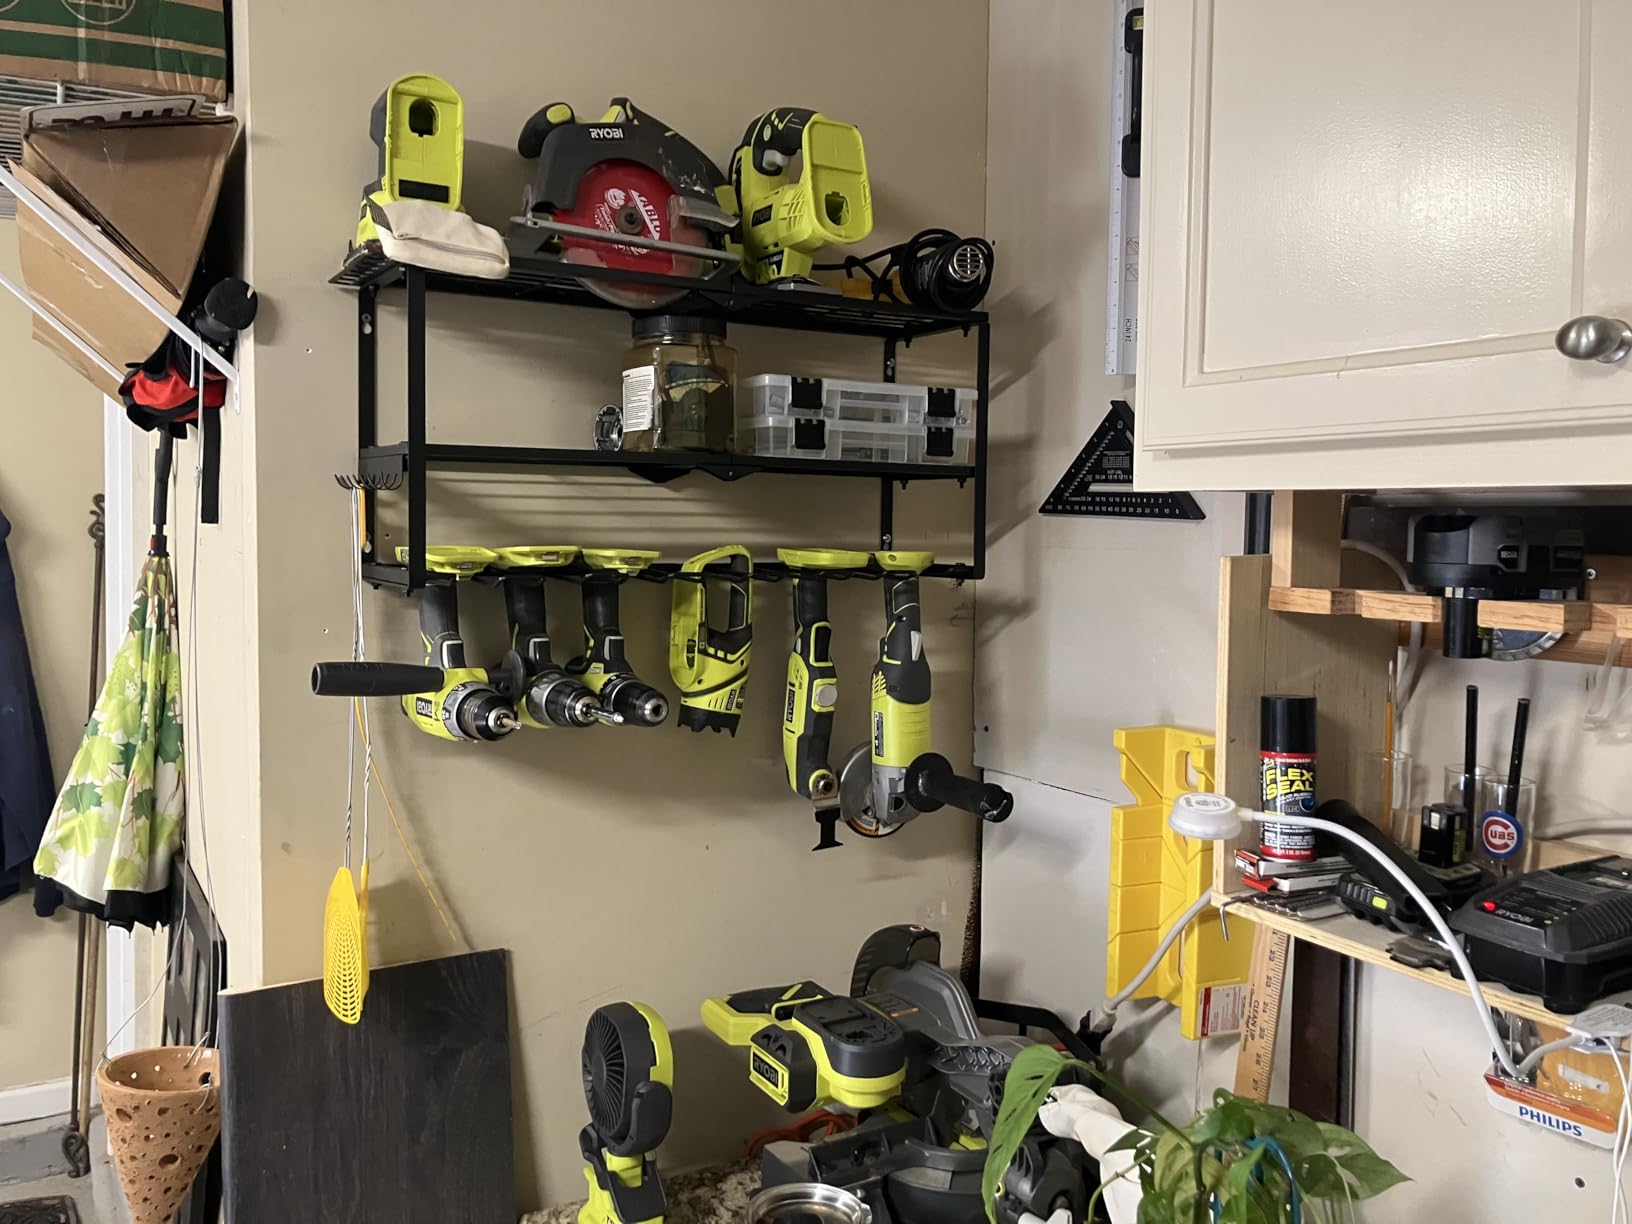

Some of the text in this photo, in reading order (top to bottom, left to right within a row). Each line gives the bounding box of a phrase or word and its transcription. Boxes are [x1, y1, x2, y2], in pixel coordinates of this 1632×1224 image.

[589, 127, 624, 139] RYOBI
[416, 699, 433, 717] RYOBI
[1265, 768, 1313, 784] FLEX
[1266, 780, 1313, 800] SEAL
[1484, 819, 1516, 852] CUBS
[1495, 909, 1535, 923] RYOBI
[1251, 1000, 1260, 1028] CLEAN
[1249, 1028, 1257, 1041] UP
[753, 1056, 778, 1085] RYOBI
[1518, 1105, 1583, 1137] PHILIPS
